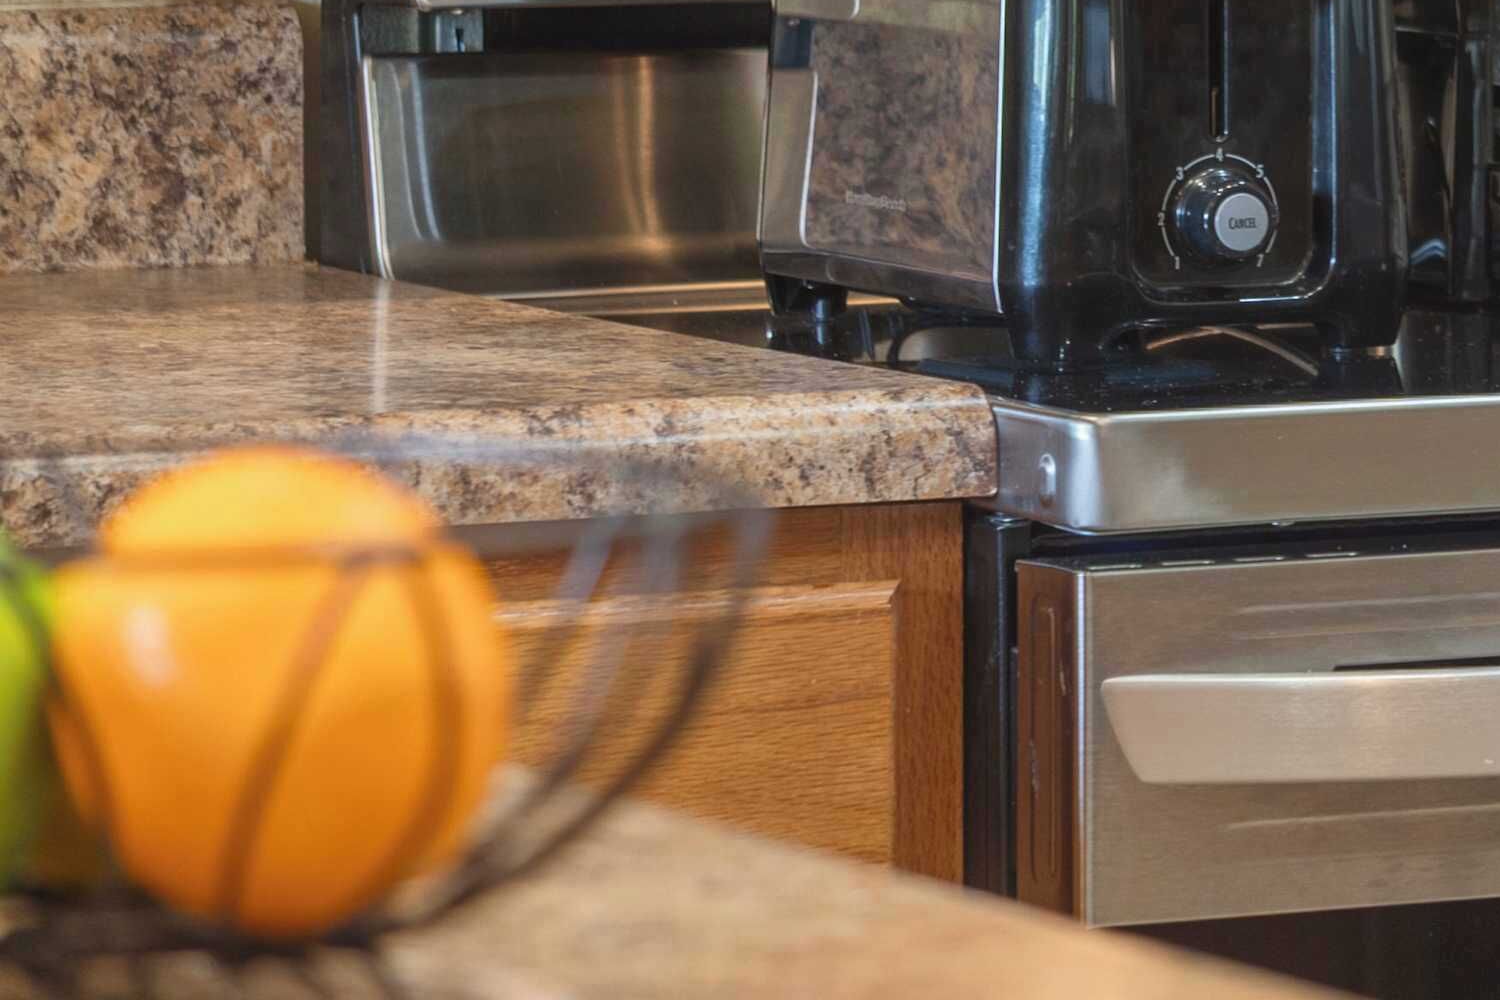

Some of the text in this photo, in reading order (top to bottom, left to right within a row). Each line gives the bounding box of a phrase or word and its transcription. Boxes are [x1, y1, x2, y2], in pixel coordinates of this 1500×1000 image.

[1175, 166, 1184, 180] 3
[1255, 164, 1265, 179] 5
[1157, 212, 1166, 226] 2
[1256, 253, 1265, 268] 7
